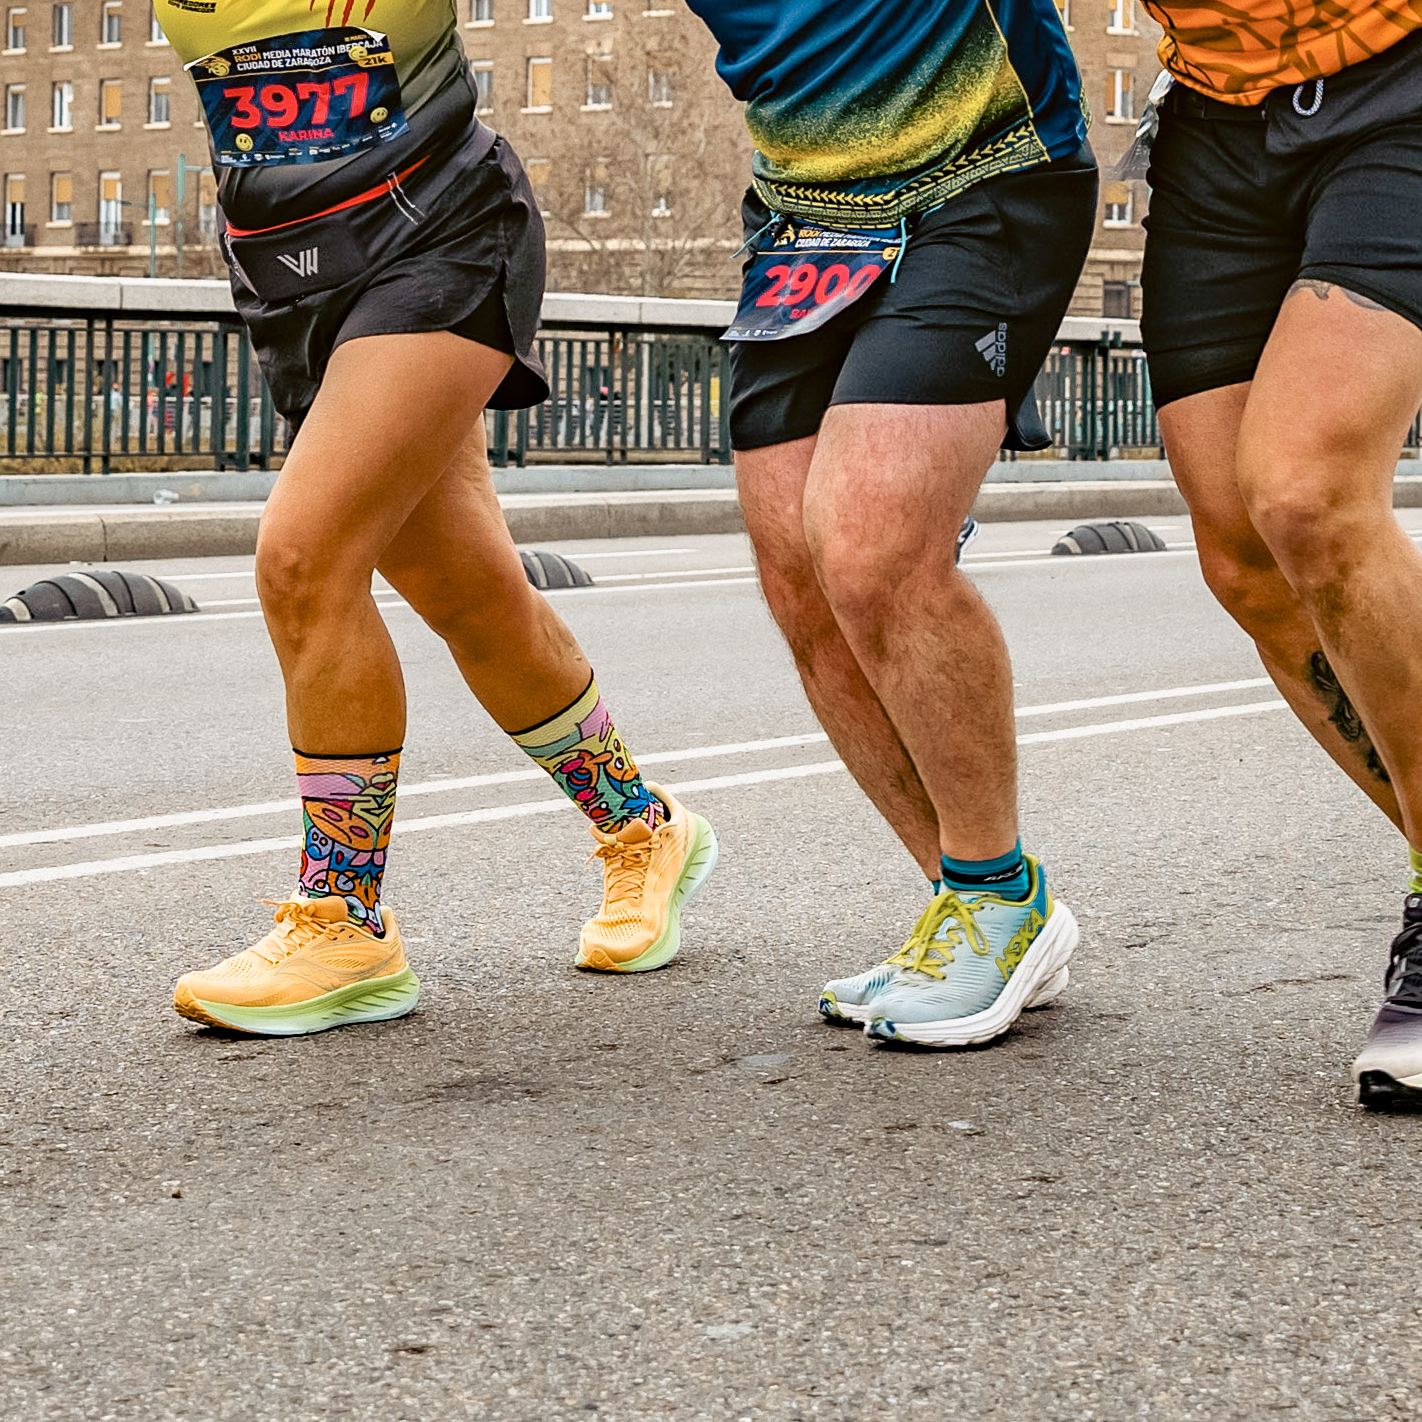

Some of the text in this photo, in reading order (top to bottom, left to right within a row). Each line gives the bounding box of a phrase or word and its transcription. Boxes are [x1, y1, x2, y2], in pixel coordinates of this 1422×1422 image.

[232, 46, 256, 56] XXVII
[234, 53, 261, 63] RODI
[262, 49, 291, 59] MEDIA
[292, 44, 336, 58] MARATÓN
[236, 56, 332, 71] CIUDAD DE ZARAGOZA
[223, 72, 369, 128] 3977
[278, 128, 335, 142] KARINA
[795, 238, 820, 248] CIUDAD
[820, 238, 830, 247] DE
[755, 263, 881, 307] 2900
[995, 322, 1008, 377] adidas
